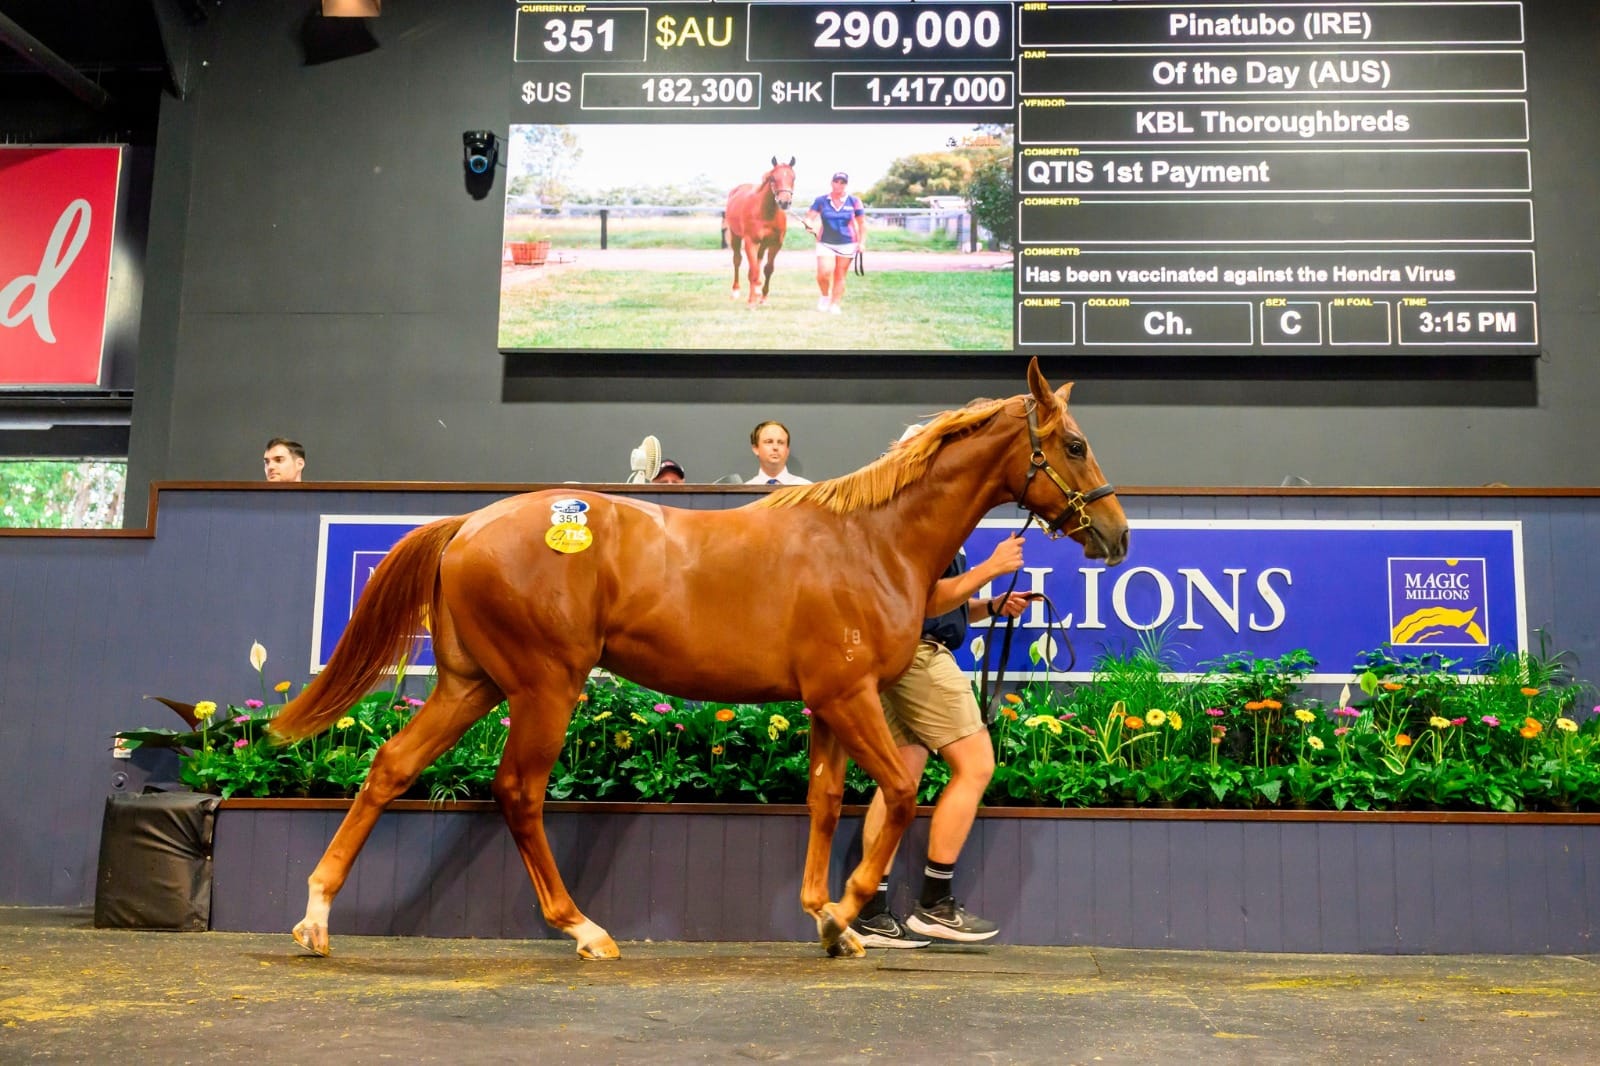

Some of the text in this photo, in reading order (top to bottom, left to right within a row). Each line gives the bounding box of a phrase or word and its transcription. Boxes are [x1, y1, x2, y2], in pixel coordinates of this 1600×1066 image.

[656, 16, 732, 49] $AU
[814, 11, 1001, 54] 290,000
[1169, 12, 1372, 38] Pinatubo (IRE)
[544, 19, 613, 52] 351
[1023, 51, 1046, 59] DAM
[1152, 60, 1391, 89] Of the Day (AUS)
[521, 80, 572, 105] $US
[641, 78, 753, 106] 182,300
[770, 80, 823, 105] $HK
[866, 77, 1006, 106] 1,417,000
[1023, 99, 1066, 107] VENDOR
[1136, 110, 1410, 137] KBL Thoroughbreds
[1023, 148, 1080, 156] COMMENTS
[1027, 160, 1270, 188] QTIS 1st Payment
[1023, 197, 1080, 206] COMMENTS
[1023, 248, 1080, 256] COMMENTS
[1025, 266, 1456, 286] Has been vaccinated against the Hendra Virus
[1023, 299, 1061, 307] ONLINE
[1087, 298, 1130, 307] COLOUR
[1265, 298, 1287, 307] SEX
[1334, 298, 1373, 306] IN FOAL
[1403, 298, 1427, 306] TIME
[1143, 311, 1193, 335] Ch.
[1280, 310, 1302, 335] C
[1419, 312, 1517, 333] 3:15 PM
[558, 514, 579, 524] 351
[1404, 573, 1470, 589] MAGIC
[1405, 589, 1470, 600] MILLIONS
